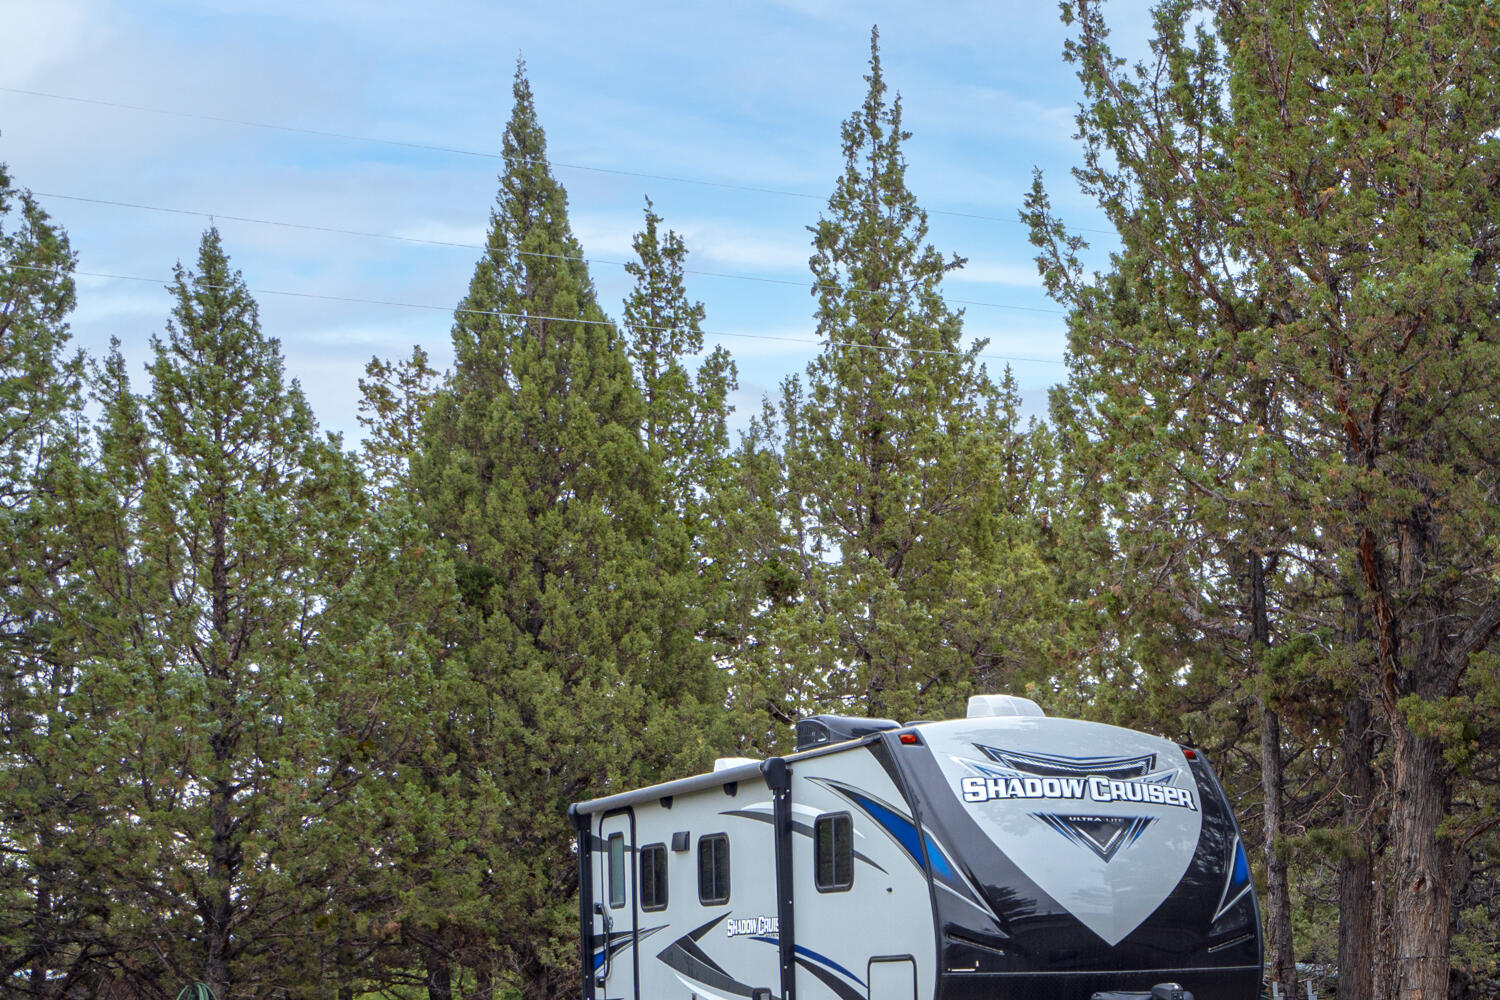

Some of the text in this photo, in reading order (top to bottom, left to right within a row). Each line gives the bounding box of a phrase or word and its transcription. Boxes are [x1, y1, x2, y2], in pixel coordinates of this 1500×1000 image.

[962, 776, 1198, 811] SHADOW CRUISER
[727, 918, 758, 937] SHADOW
